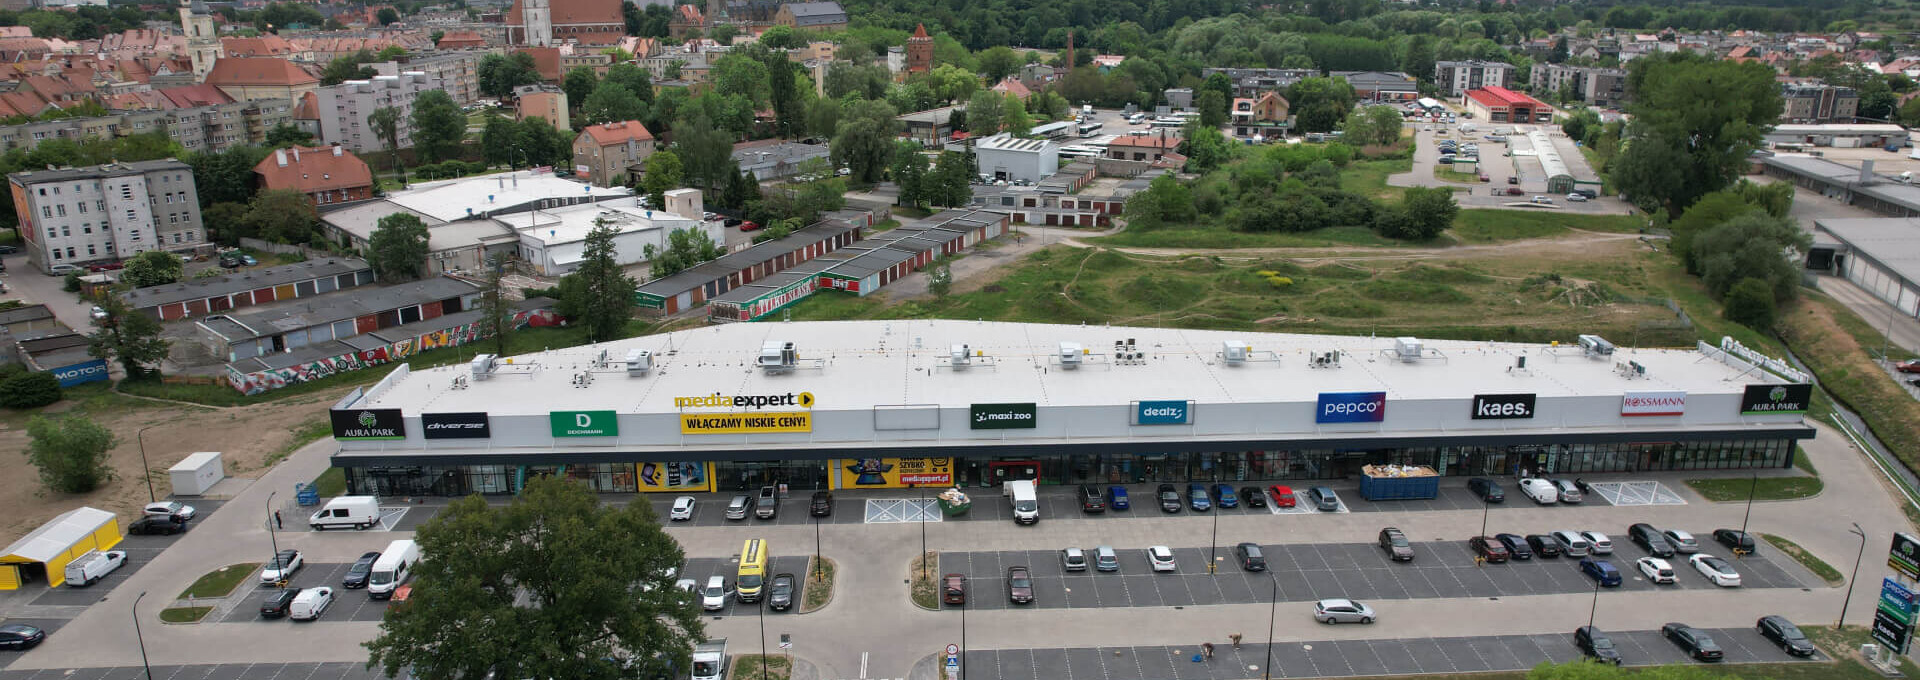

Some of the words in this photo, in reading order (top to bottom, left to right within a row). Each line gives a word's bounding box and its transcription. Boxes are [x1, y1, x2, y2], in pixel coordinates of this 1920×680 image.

[55, 364, 106, 380] MOTOR
[674, 391, 795, 409] mediaexpert
[1623, 397, 1686, 408] ROSSMANN
[1143, 407, 1180, 418] dealz
[1477, 399, 1531, 416] kaes.
[1751, 403, 1776, 412] AURA
[1777, 402, 1800, 411] PARK
[575, 413, 592, 428] D
[988, 411, 1012, 420] maxi
[1013, 412, 1032, 420] zoo
[426, 422, 485, 430] diverse
[686, 418, 742, 430] WŁĄCZAMY
[744, 417, 777, 428] NISKIE
[778, 416, 806, 428] CENY!
[344, 428, 370, 437] AURA
[371, 428, 395, 437] PARK
